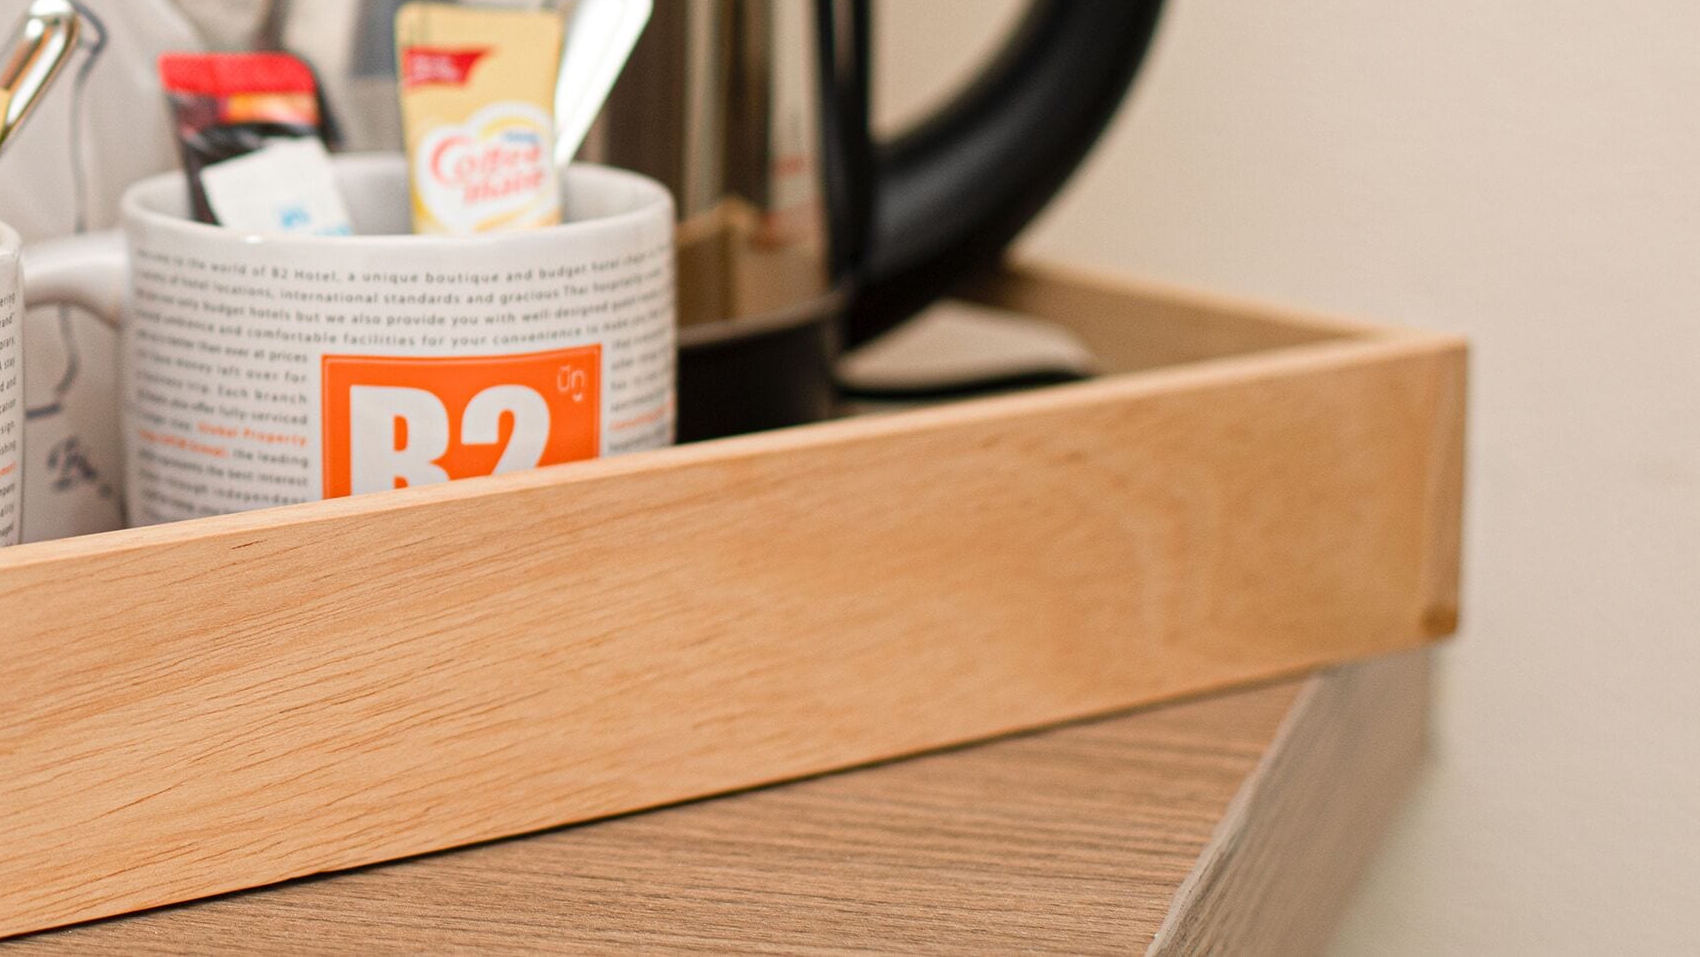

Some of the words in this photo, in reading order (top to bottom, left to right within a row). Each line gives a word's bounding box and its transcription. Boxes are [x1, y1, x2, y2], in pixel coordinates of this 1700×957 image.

[428, 135, 543, 189] Coffee
[211, 262, 246, 275] world
[251, 265, 266, 276] of
[272, 267, 288, 279] B2
[348, 273, 355, 282] a
[362, 271, 419, 284] unique
[425, 272, 499, 285] boutique
[506, 269, 532, 282] and
[539, 264, 587, 279] budget
[280, 290, 378, 304] international
[384, 293, 461, 305] standards
[466, 293, 494, 305] and
[500, 288, 560, 304] gracious
[250, 307, 291, 321] hotels
[296, 310, 320, 323] but
[325, 314, 346, 324] we
[351, 313, 381, 325] also
[386, 313, 445, 327] provide
[452, 315, 479, 327] you
[484, 312, 516, 324] with
[247, 328, 337, 344] comfortable
[343, 332, 416, 346] facilities
[422, 334, 444, 346] for
[450, 336, 487, 348] your
[492, 327, 582, 346] convenience
[269, 350, 308, 364] prices
[246, 370, 278, 381] over
[285, 371, 307, 384] for
[217, 384, 248, 398] Each
[254, 387, 308, 404] branch
[350, 384, 550, 496] B2
[257, 452, 309, 469] leading
